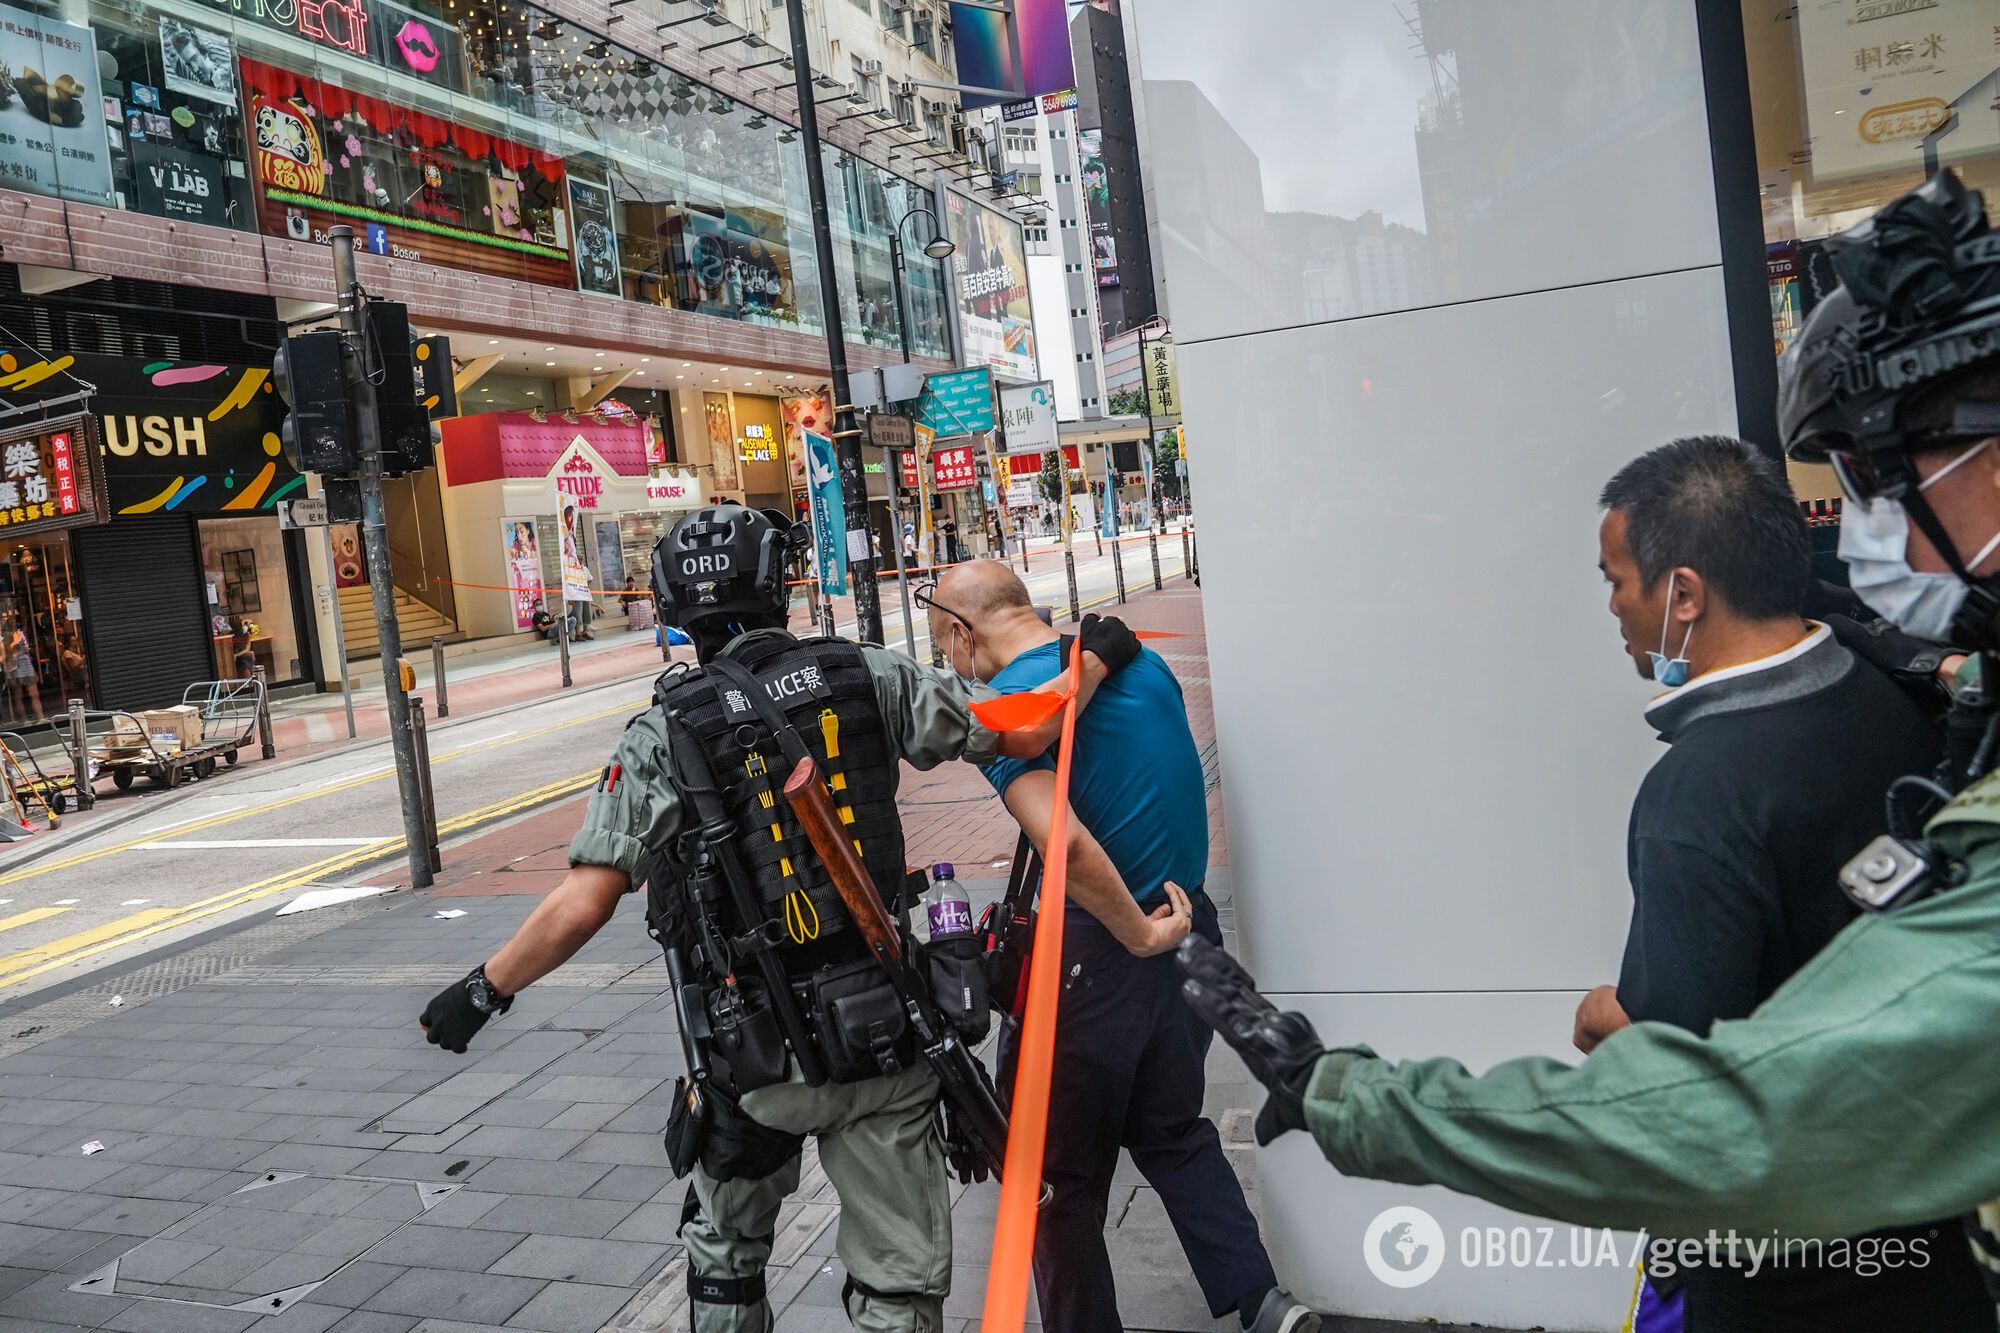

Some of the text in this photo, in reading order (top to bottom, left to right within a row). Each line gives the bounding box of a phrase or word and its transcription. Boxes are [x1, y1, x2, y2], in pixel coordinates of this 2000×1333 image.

[392, 244, 420, 262] Boson
[100, 415, 207, 456] USH
[556, 476, 604, 496] ETUDE
[682, 553, 731, 577] ORD
